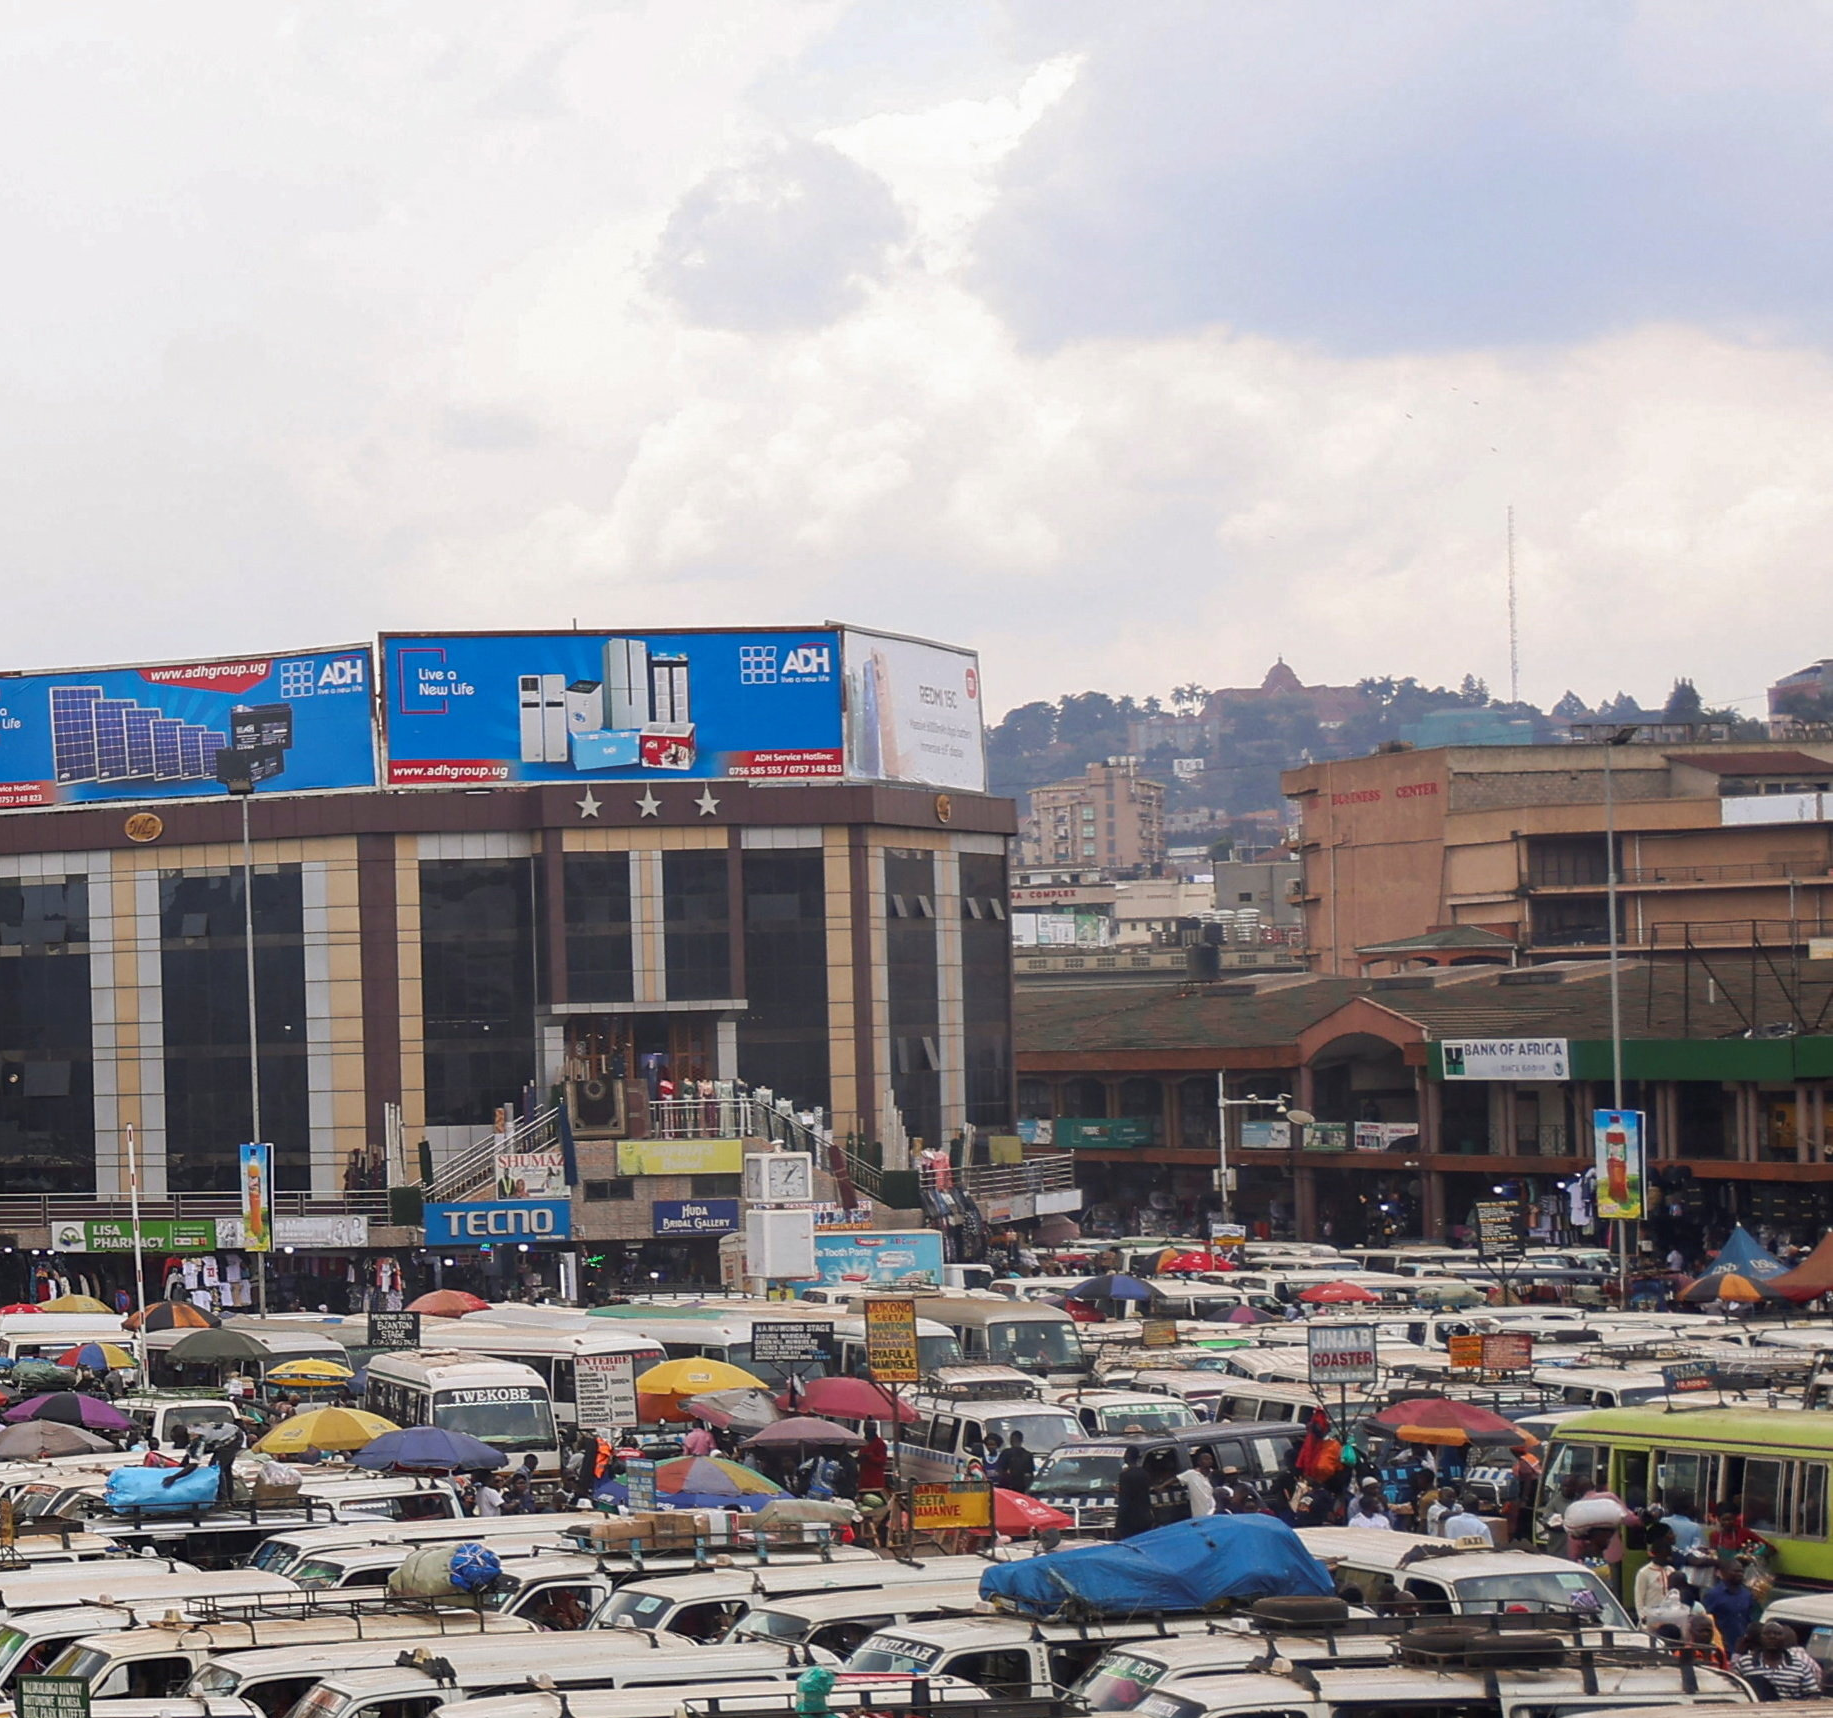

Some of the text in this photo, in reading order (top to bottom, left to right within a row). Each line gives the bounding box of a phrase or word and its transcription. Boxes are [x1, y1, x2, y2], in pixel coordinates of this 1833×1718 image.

[781, 646, 830, 673] ADH
[150, 658, 362, 686] www.adhgroup.ug ADH
[418, 668, 445, 681] Live
[418, 682, 475, 695] New Life
[393, 765, 508, 781] www.adhgroup.ug
[1464, 1042, 1562, 1056] BANK OF AFRICA
[682, 1204, 708, 1217] HUDA
[443, 1208, 553, 1236] TECNO
[92, 1224, 121, 1235] LISA
[92, 1237, 165, 1249] PHARMACY
[806, 1324, 830, 1332] STAGE
[1312, 1351, 1373, 1367] COASTER
[451, 1387, 530, 1403] TWEKOBE
